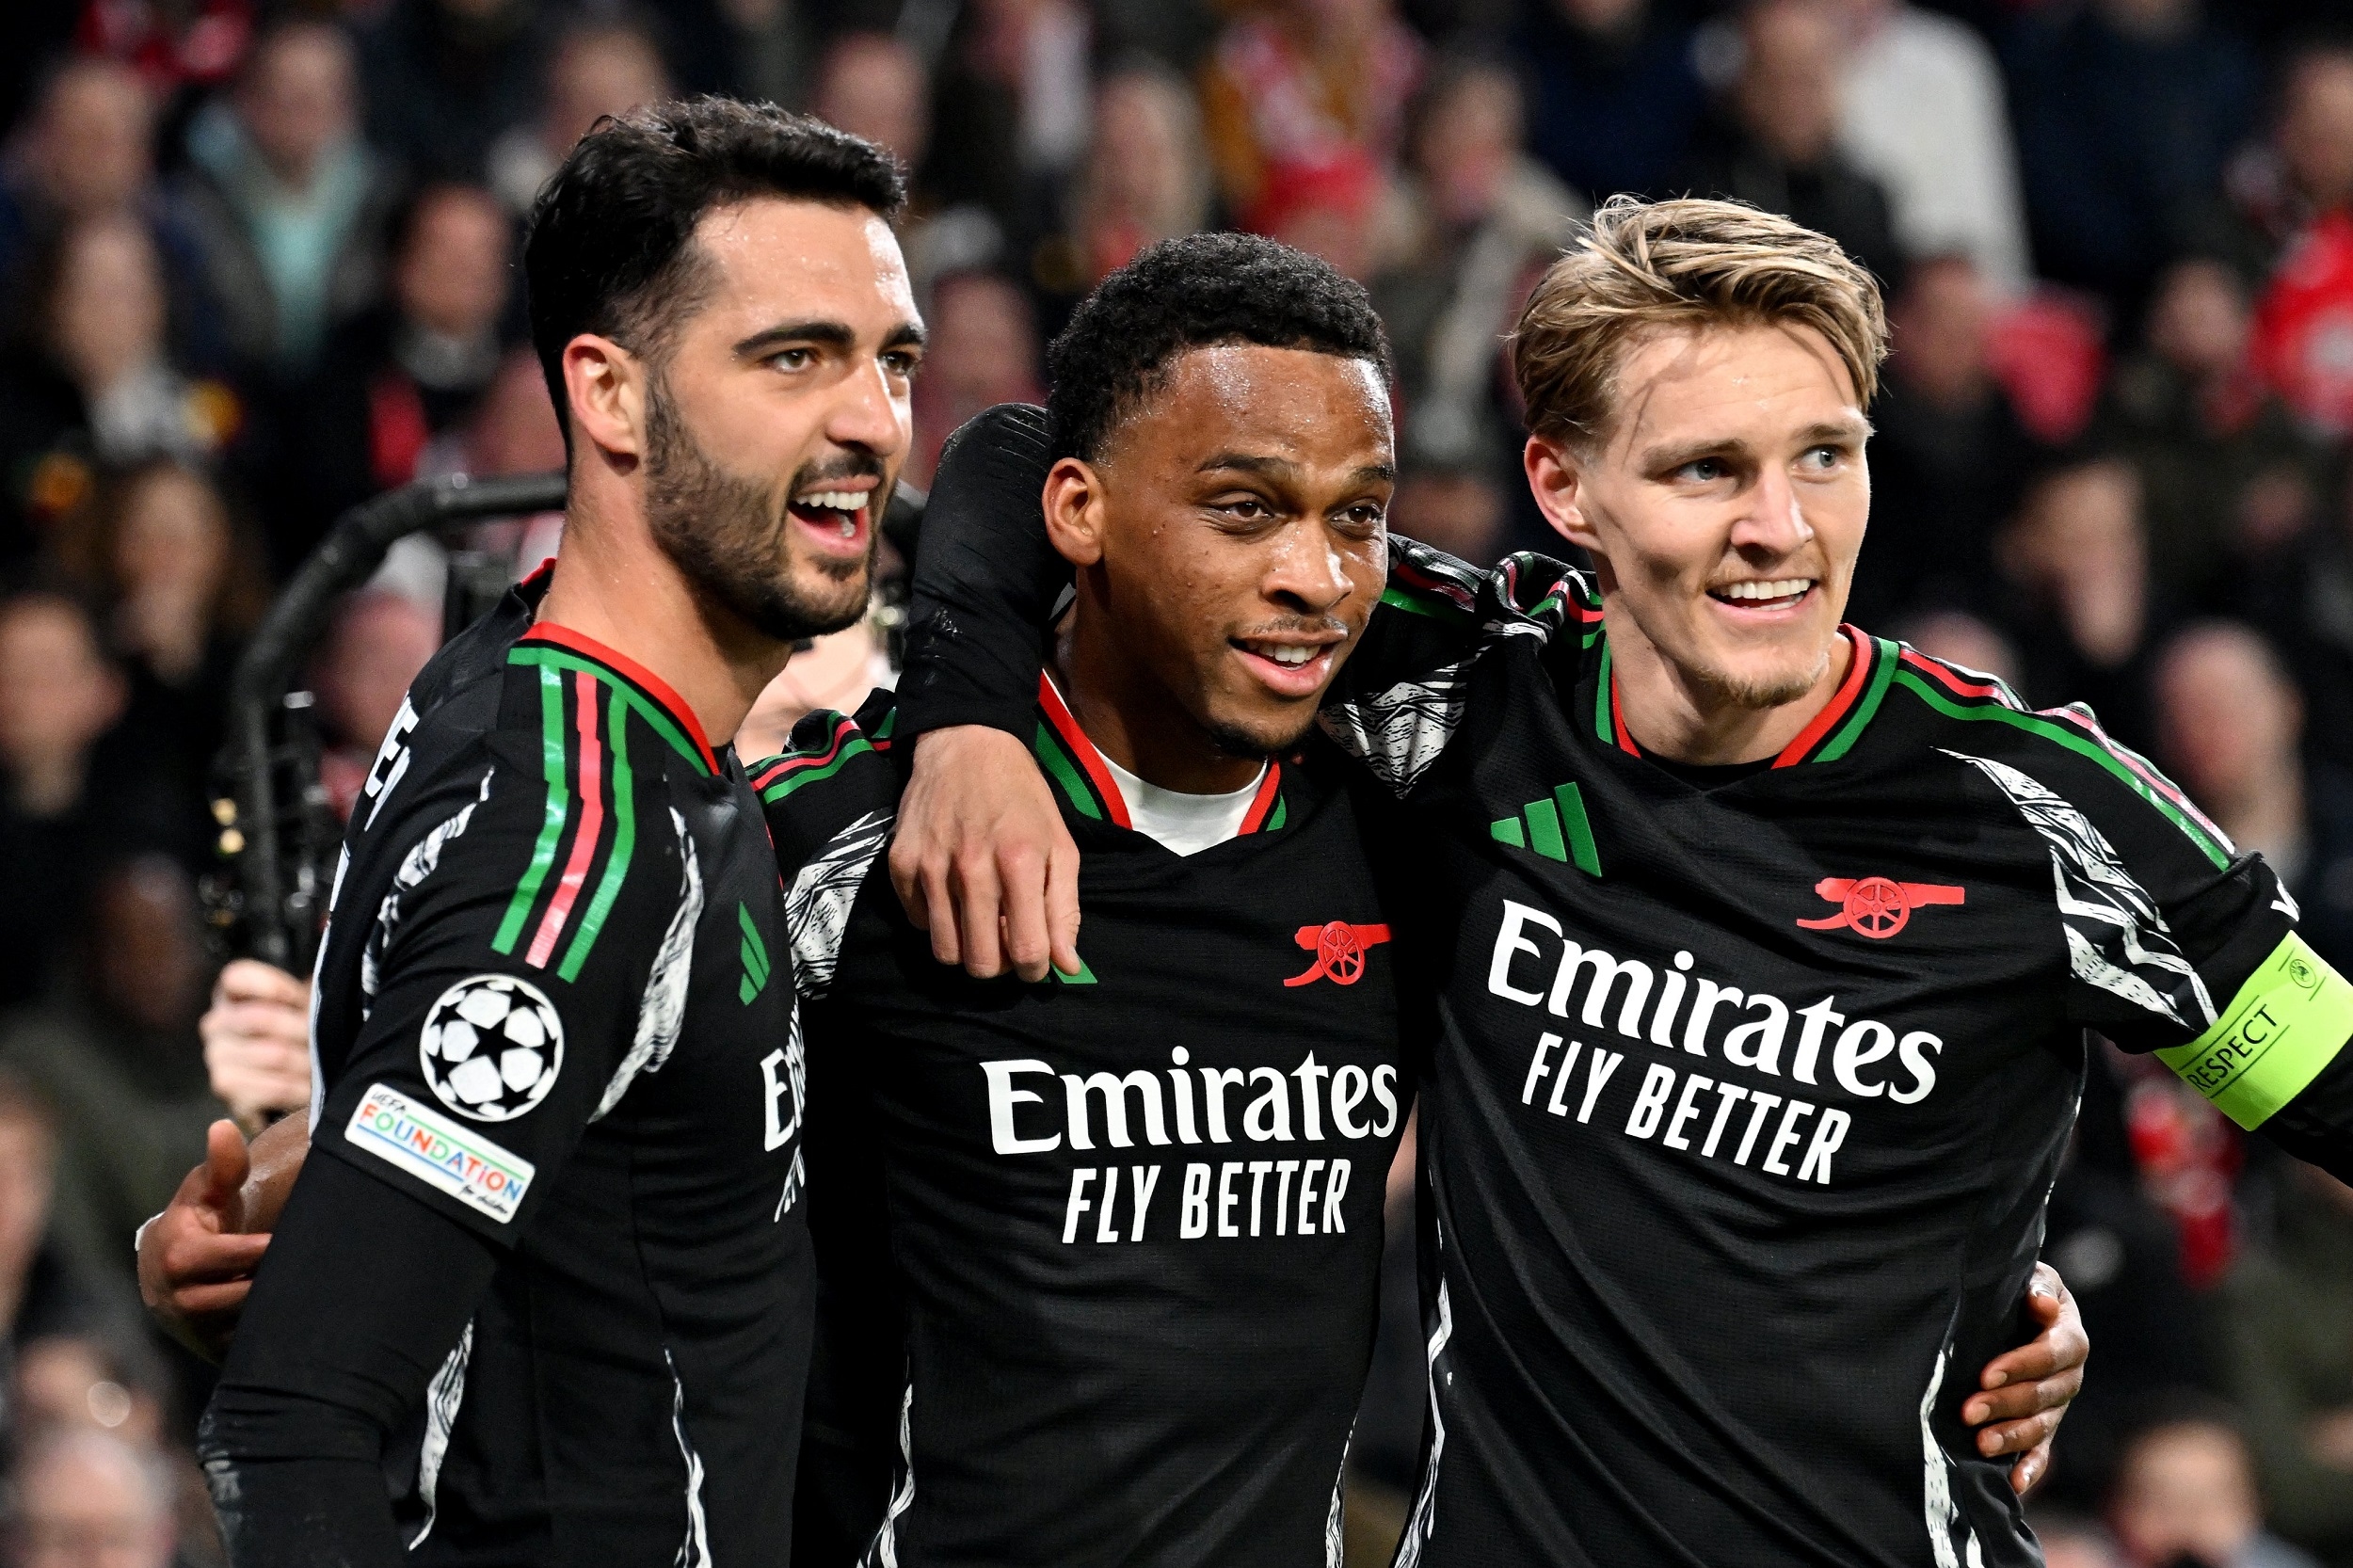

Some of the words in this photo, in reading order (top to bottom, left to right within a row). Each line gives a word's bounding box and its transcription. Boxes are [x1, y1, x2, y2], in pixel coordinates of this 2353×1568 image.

[1487, 899, 1944, 1105] Emirates
[2186, 1003, 2278, 1093] RESPECT
[979, 1046, 1399, 1155] Emirates
[1521, 1032, 1625, 1125] FLY
[1625, 1063, 1851, 1185] BETTER
[1062, 1164, 1161, 1244] FLY
[1179, 1159, 1352, 1240] BETTER
